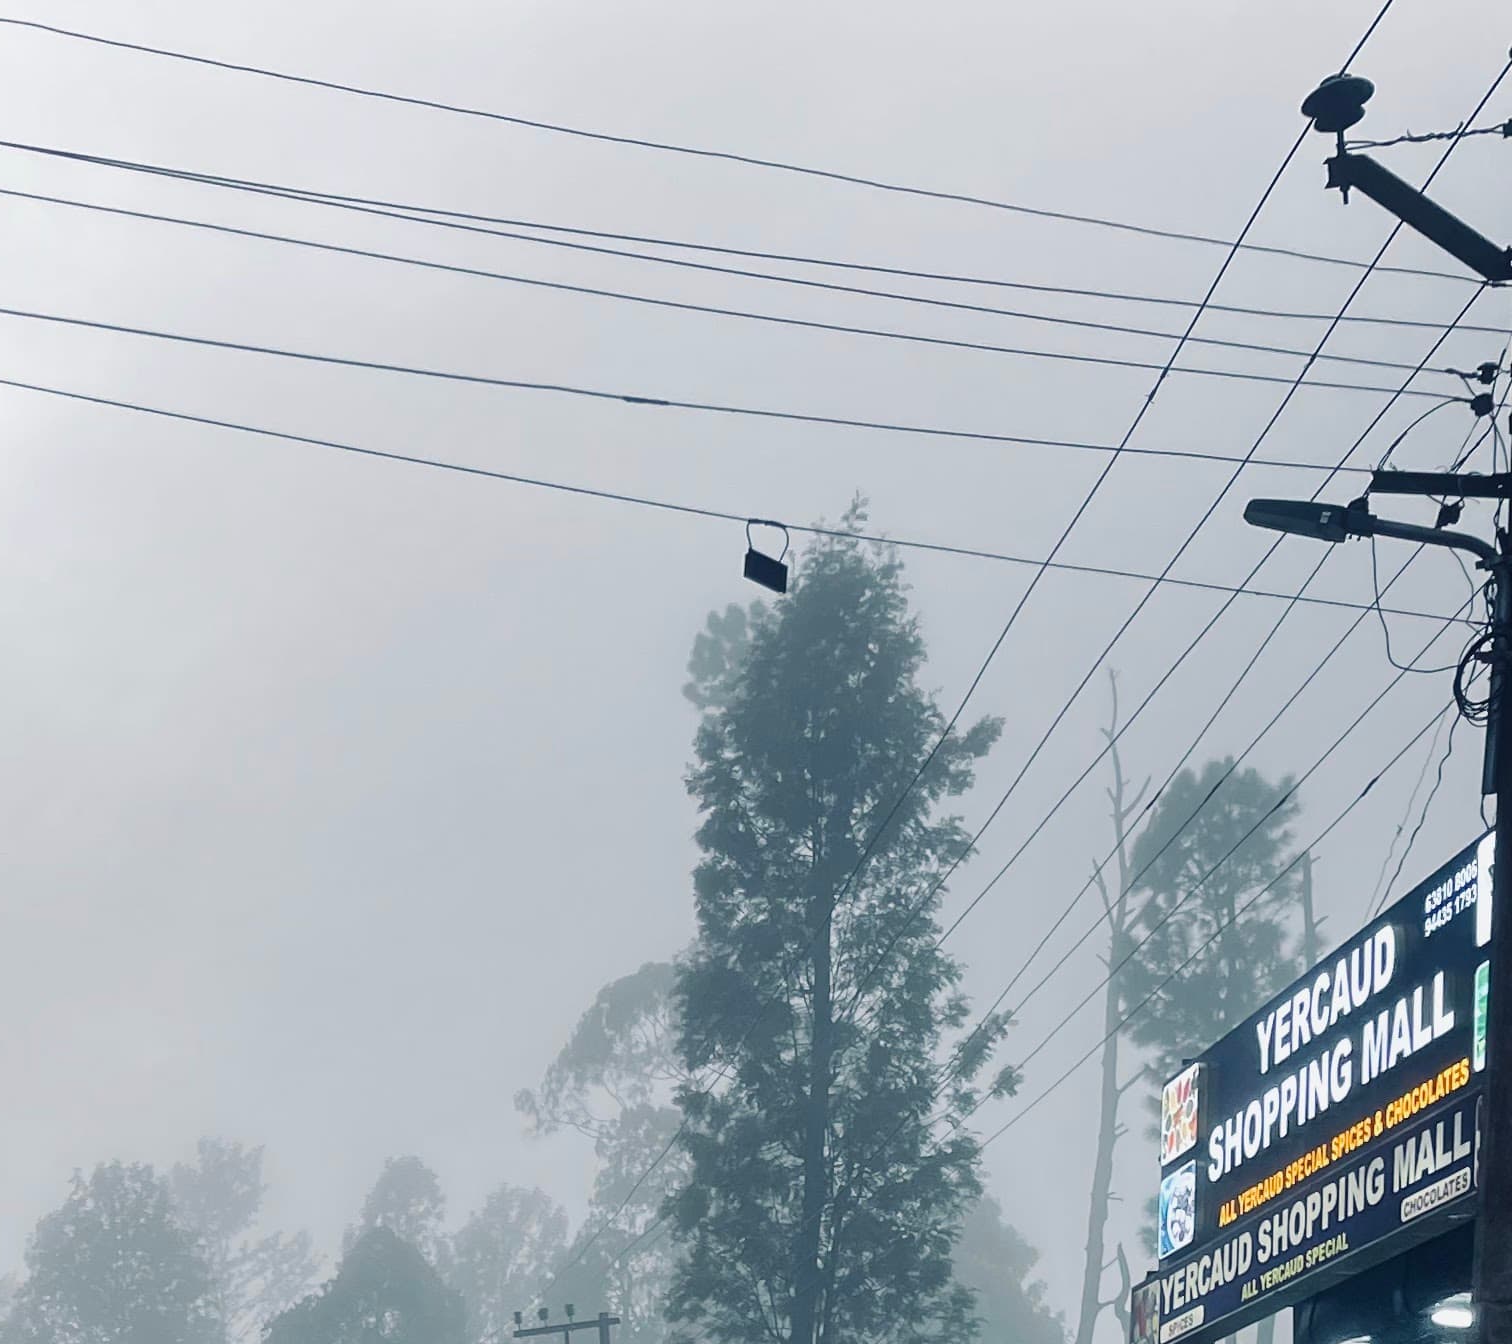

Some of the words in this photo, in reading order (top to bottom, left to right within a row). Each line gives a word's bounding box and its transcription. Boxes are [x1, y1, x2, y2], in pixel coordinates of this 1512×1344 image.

[1256, 925, 1396, 1075] YERCAUD
[1208, 1038, 1353, 1182] SHOPPING
[1361, 971, 1455, 1085] MALL
[1219, 1201, 1238, 1228] ALL
[1237, 1170, 1284, 1215] YERCAUD
[1285, 1143, 1330, 1189] SPECIAL
[1331, 1117, 1373, 1161] SPICES
[1373, 1110, 1384, 1138] &
[1385, 1057, 1470, 1129] CHOCOLATES
[1161, 1230, 1252, 1316] YERCAUD
[1257, 1156, 1385, 1265] SHOPPING
[1393, 1111, 1471, 1193] MALL
[1241, 1277, 1259, 1303] ALL
[1260, 1253, 1304, 1292] YERCAUD
[1306, 1232, 1349, 1269] SPECIAL
[1403, 1170, 1469, 1218] CHOCOLATES
[1168, 1315, 1194, 1338] SPICES
